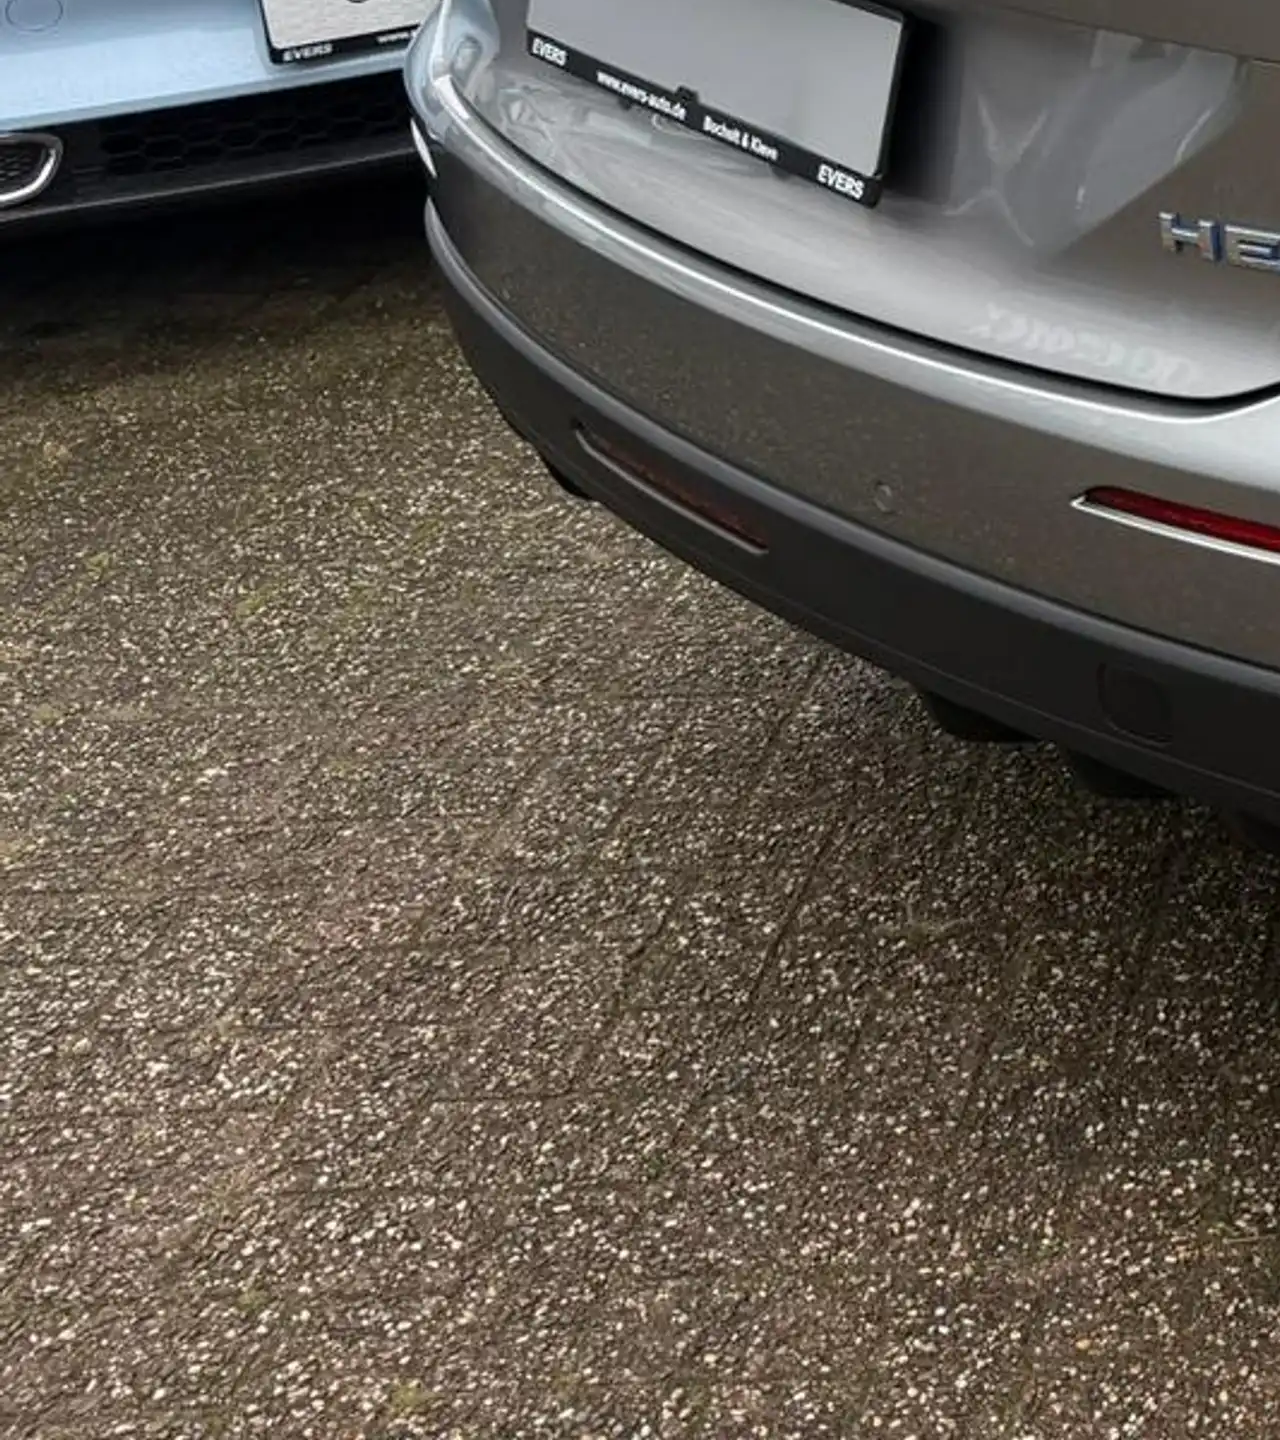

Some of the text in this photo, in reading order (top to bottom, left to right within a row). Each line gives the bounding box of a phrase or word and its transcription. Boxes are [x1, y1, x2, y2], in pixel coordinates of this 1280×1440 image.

[282, 42, 333, 62] EVERS
[531, 37, 568, 66] EVERS
[702, 115, 741, 145] Bocholt
[817, 163, 865, 201] EVERS
